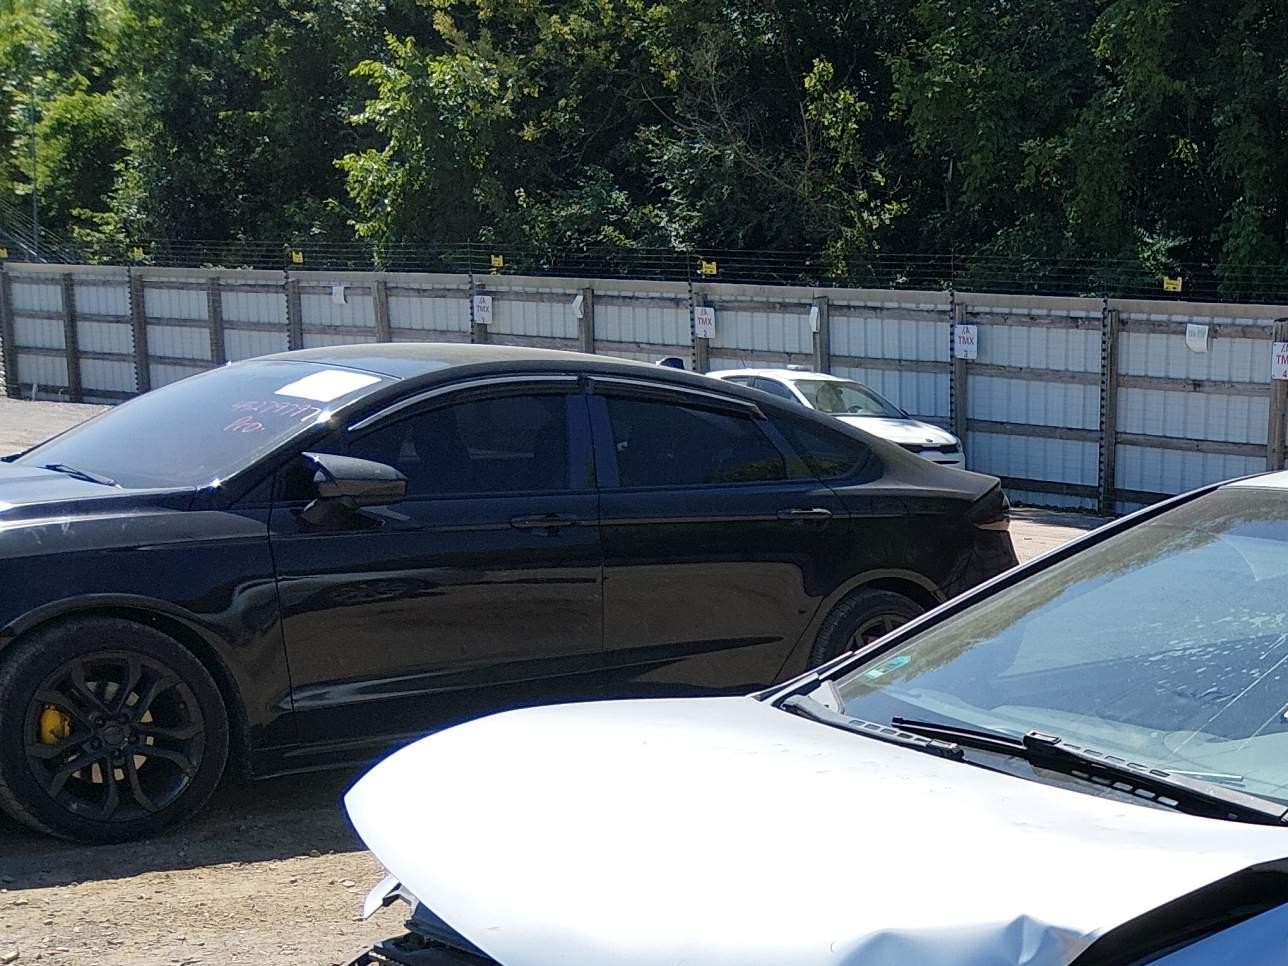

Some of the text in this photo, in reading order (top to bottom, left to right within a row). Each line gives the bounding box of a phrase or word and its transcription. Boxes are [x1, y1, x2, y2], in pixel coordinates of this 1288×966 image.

[697, 316, 712, 326] TMX
[958, 335, 975, 345] TMX
[1282, 369, 1288, 378] 4
